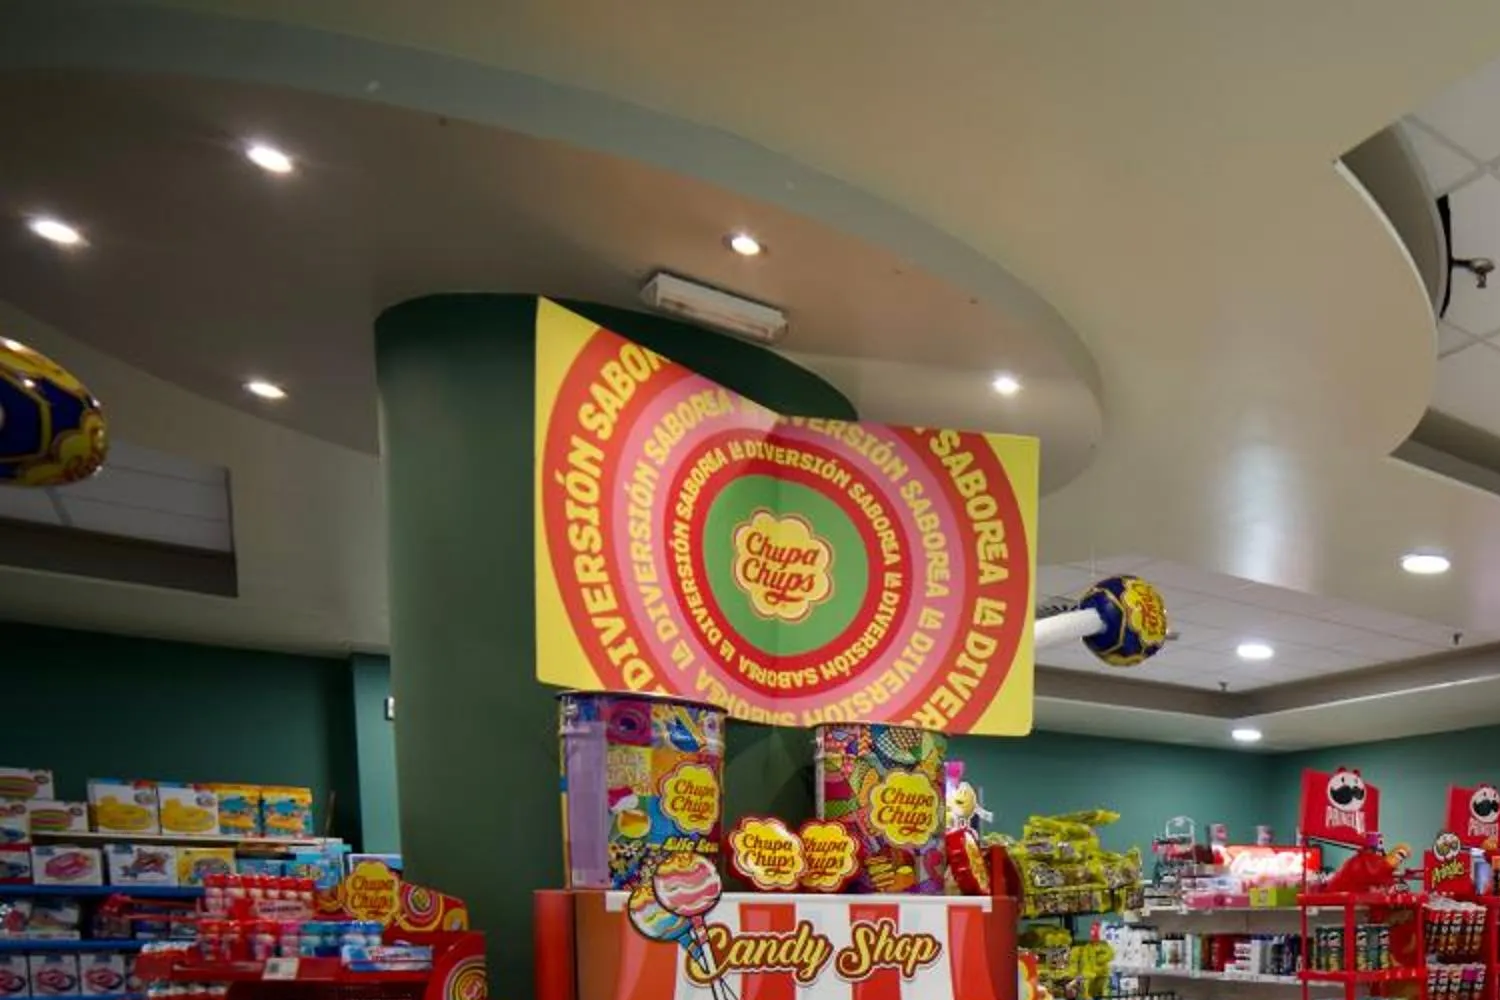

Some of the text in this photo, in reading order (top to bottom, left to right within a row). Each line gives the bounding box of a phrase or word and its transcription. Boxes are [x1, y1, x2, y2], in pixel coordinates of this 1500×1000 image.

[644, 388, 735, 466] SABOREA
[727, 440, 745, 462] LA
[676, 448, 728, 518] SABOREA
[744, 440, 852, 489] DIVERSIÓN
[848, 483, 901, 566] SABOREA
[901, 479, 950, 597] SABOREA
[929, 429, 1009, 585] SABOREA
[973, 597, 1007, 627] LA
[555, 434, 655, 691] DIVERSIÓN
[624, 459, 680, 643] DIVERSIÓN
[746, 531, 820, 569] Chupa
[669, 521, 723, 646] DIVERSIÓN
[742, 557, 816, 606] Chups
[884, 572, 903, 590] LA
[820, 592, 900, 681] DIVERSIÓN
[918, 605, 945, 630] LA
[671, 639, 696, 671] LA
[719, 639, 736, 662] LA
[739, 656, 819, 689] SABOREA
[801, 630, 935, 727] DIVERSIÓN
[876, 806, 933, 835] Chups
[880, 786, 933, 811] Chupa
[742, 832, 793, 854] Chupa
[744, 851, 796, 876] Chups
[685, 921, 942, 983] Candy Shop
